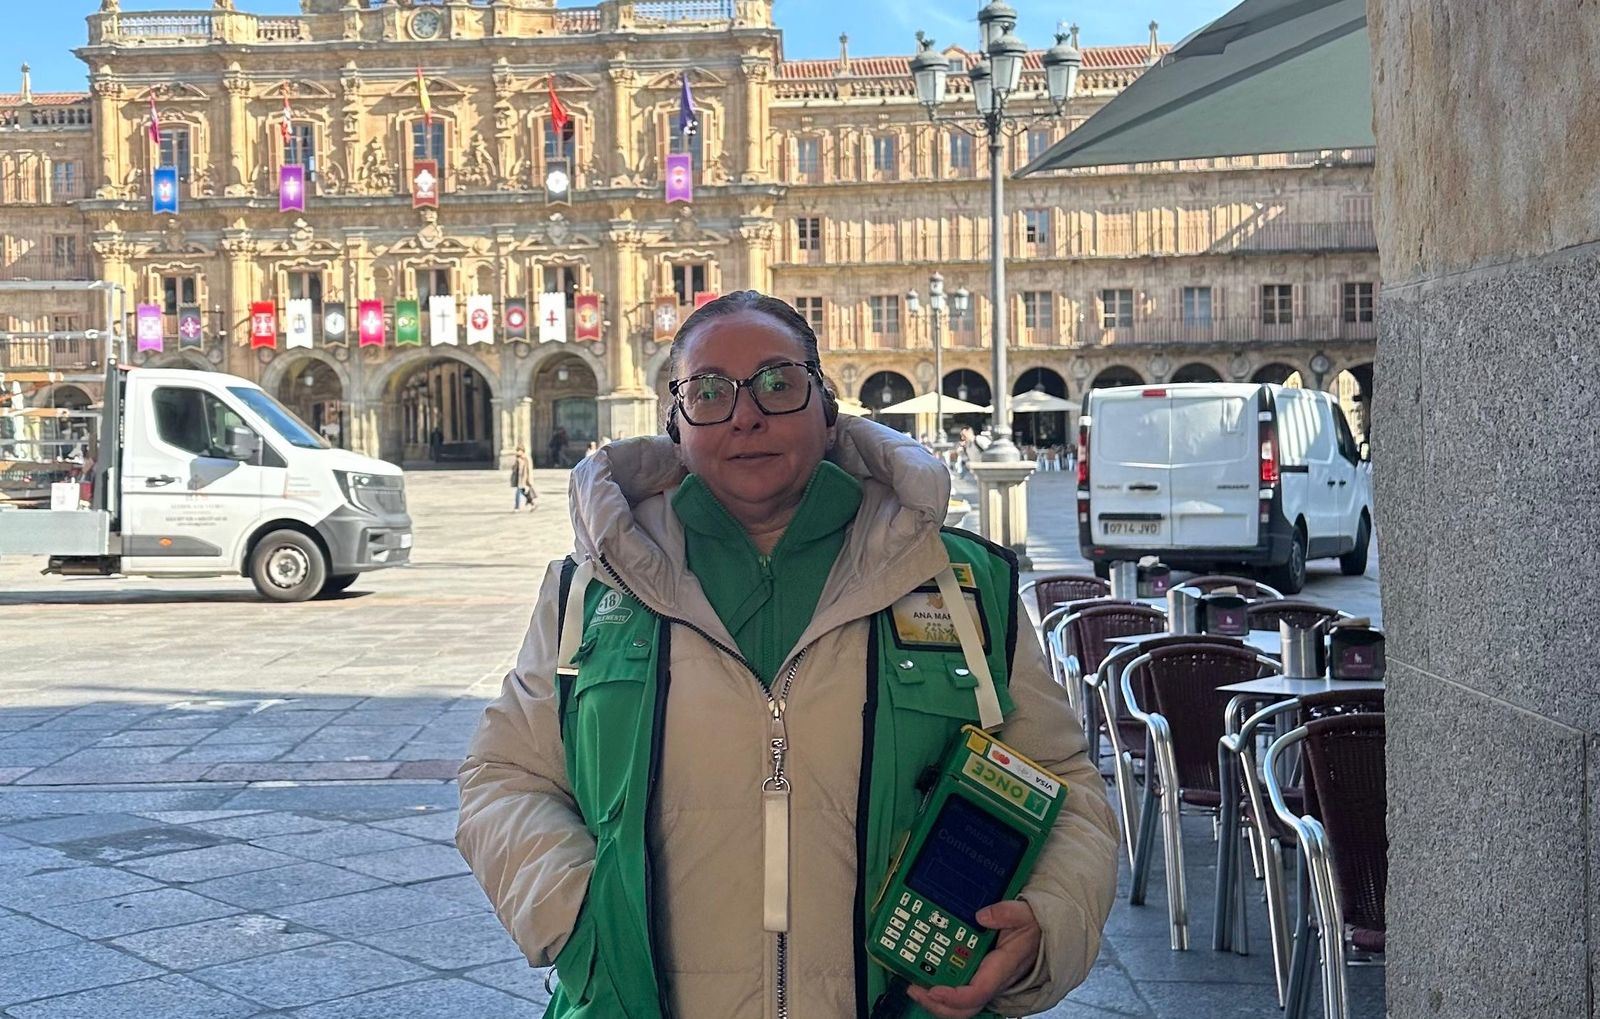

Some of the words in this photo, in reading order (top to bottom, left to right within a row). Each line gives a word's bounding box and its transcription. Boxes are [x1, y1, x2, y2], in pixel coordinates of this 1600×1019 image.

[1110, 522, 1135, 534] 0714
[913, 611, 933, 620] ANA
[971, 761, 1024, 799] ONCE
[1035, 776, 1053, 791] VISA
